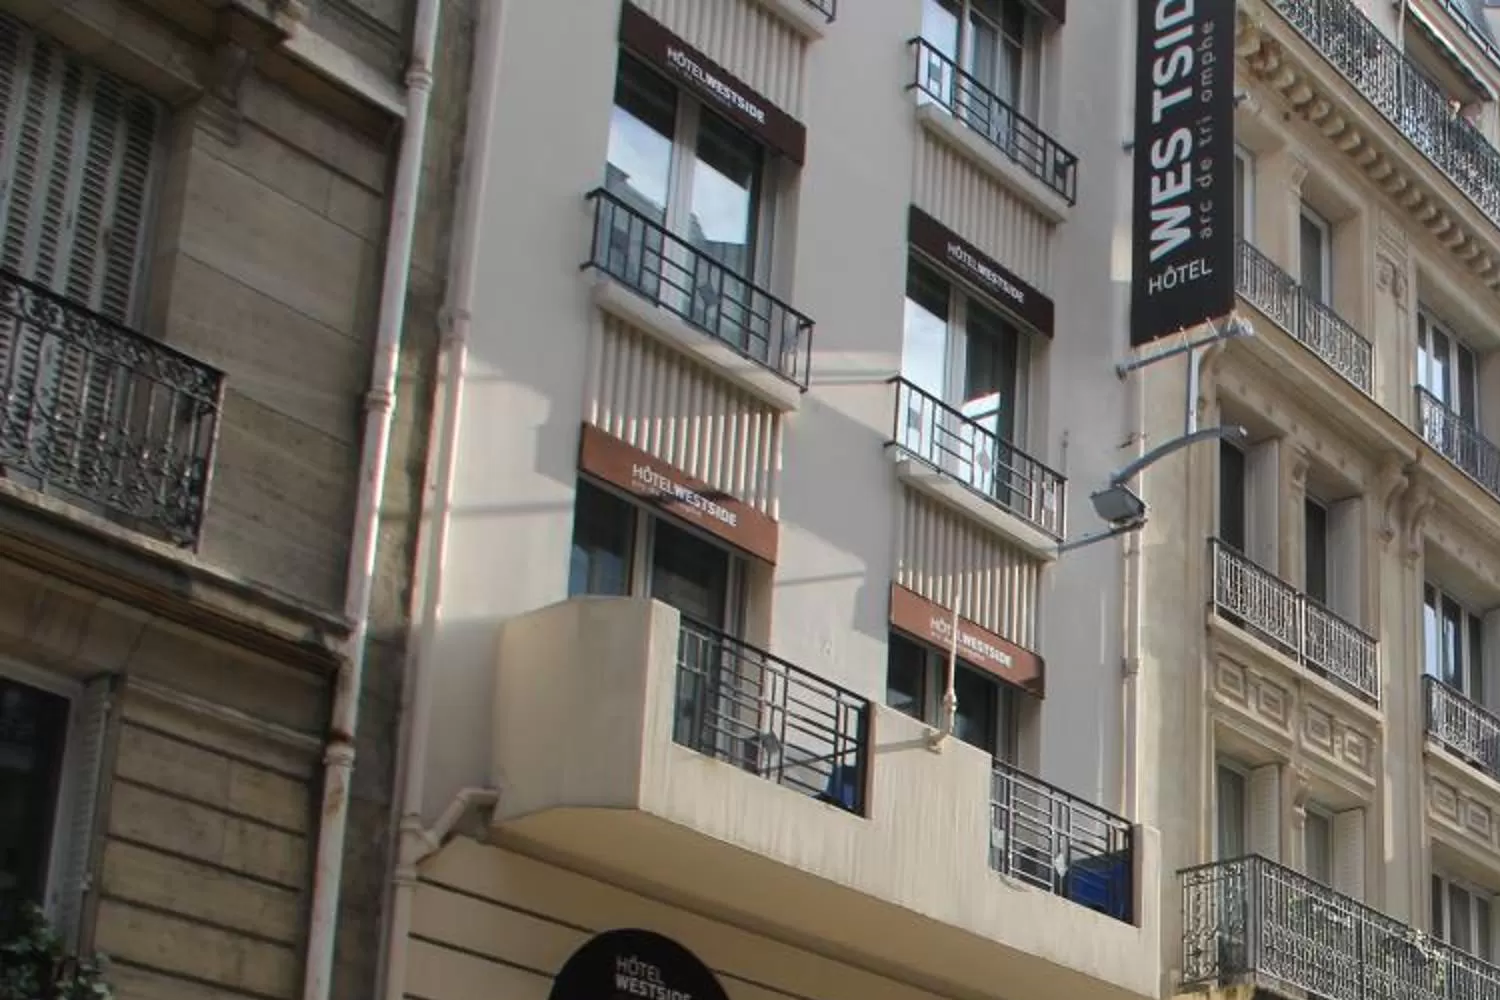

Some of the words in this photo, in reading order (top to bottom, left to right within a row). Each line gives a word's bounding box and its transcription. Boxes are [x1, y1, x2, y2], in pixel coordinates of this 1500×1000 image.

[1196, 157, 1213, 188] de
[1148, 259, 1213, 295] HÔTEL
[615, 954, 666, 987] HÔTEL
